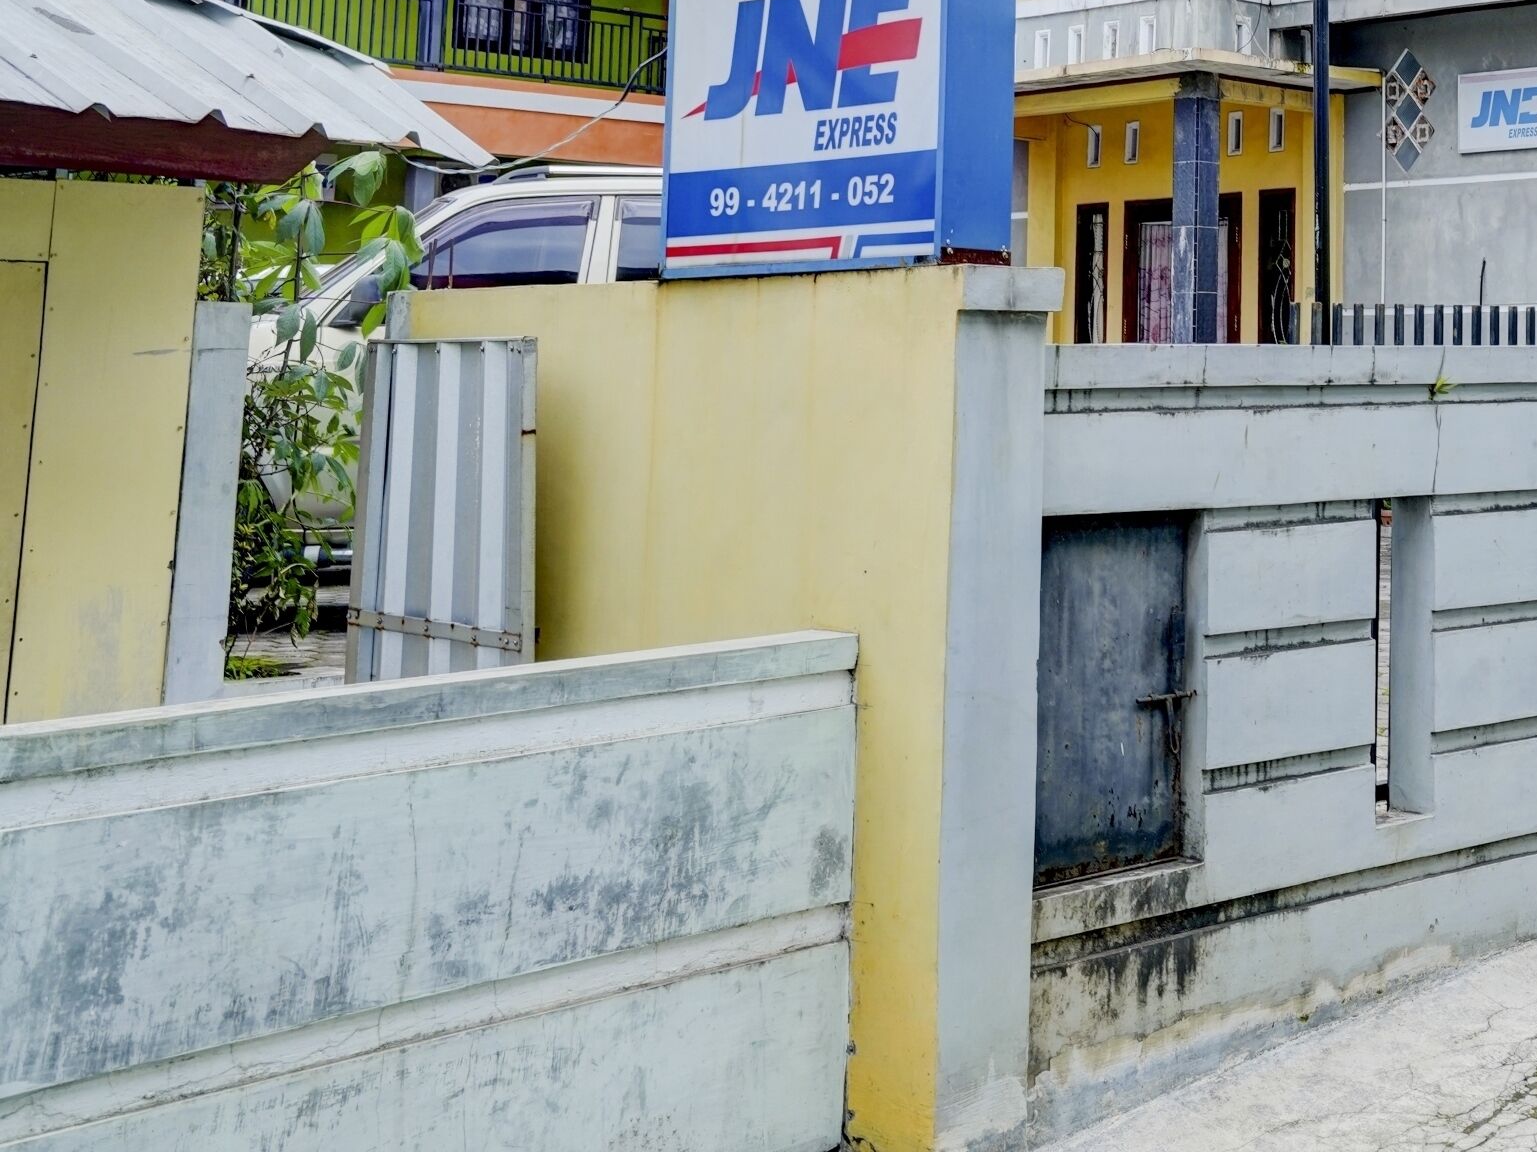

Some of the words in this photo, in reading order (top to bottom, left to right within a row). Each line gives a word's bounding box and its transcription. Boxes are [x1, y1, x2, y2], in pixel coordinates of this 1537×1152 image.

[813, 111, 898, 152] EXPRESS
[1508, 127, 1537, 139] EXPRESS
[710, 186, 740, 217] 99
[762, 179, 822, 213] 4211
[847, 173, 896, 208] 052
